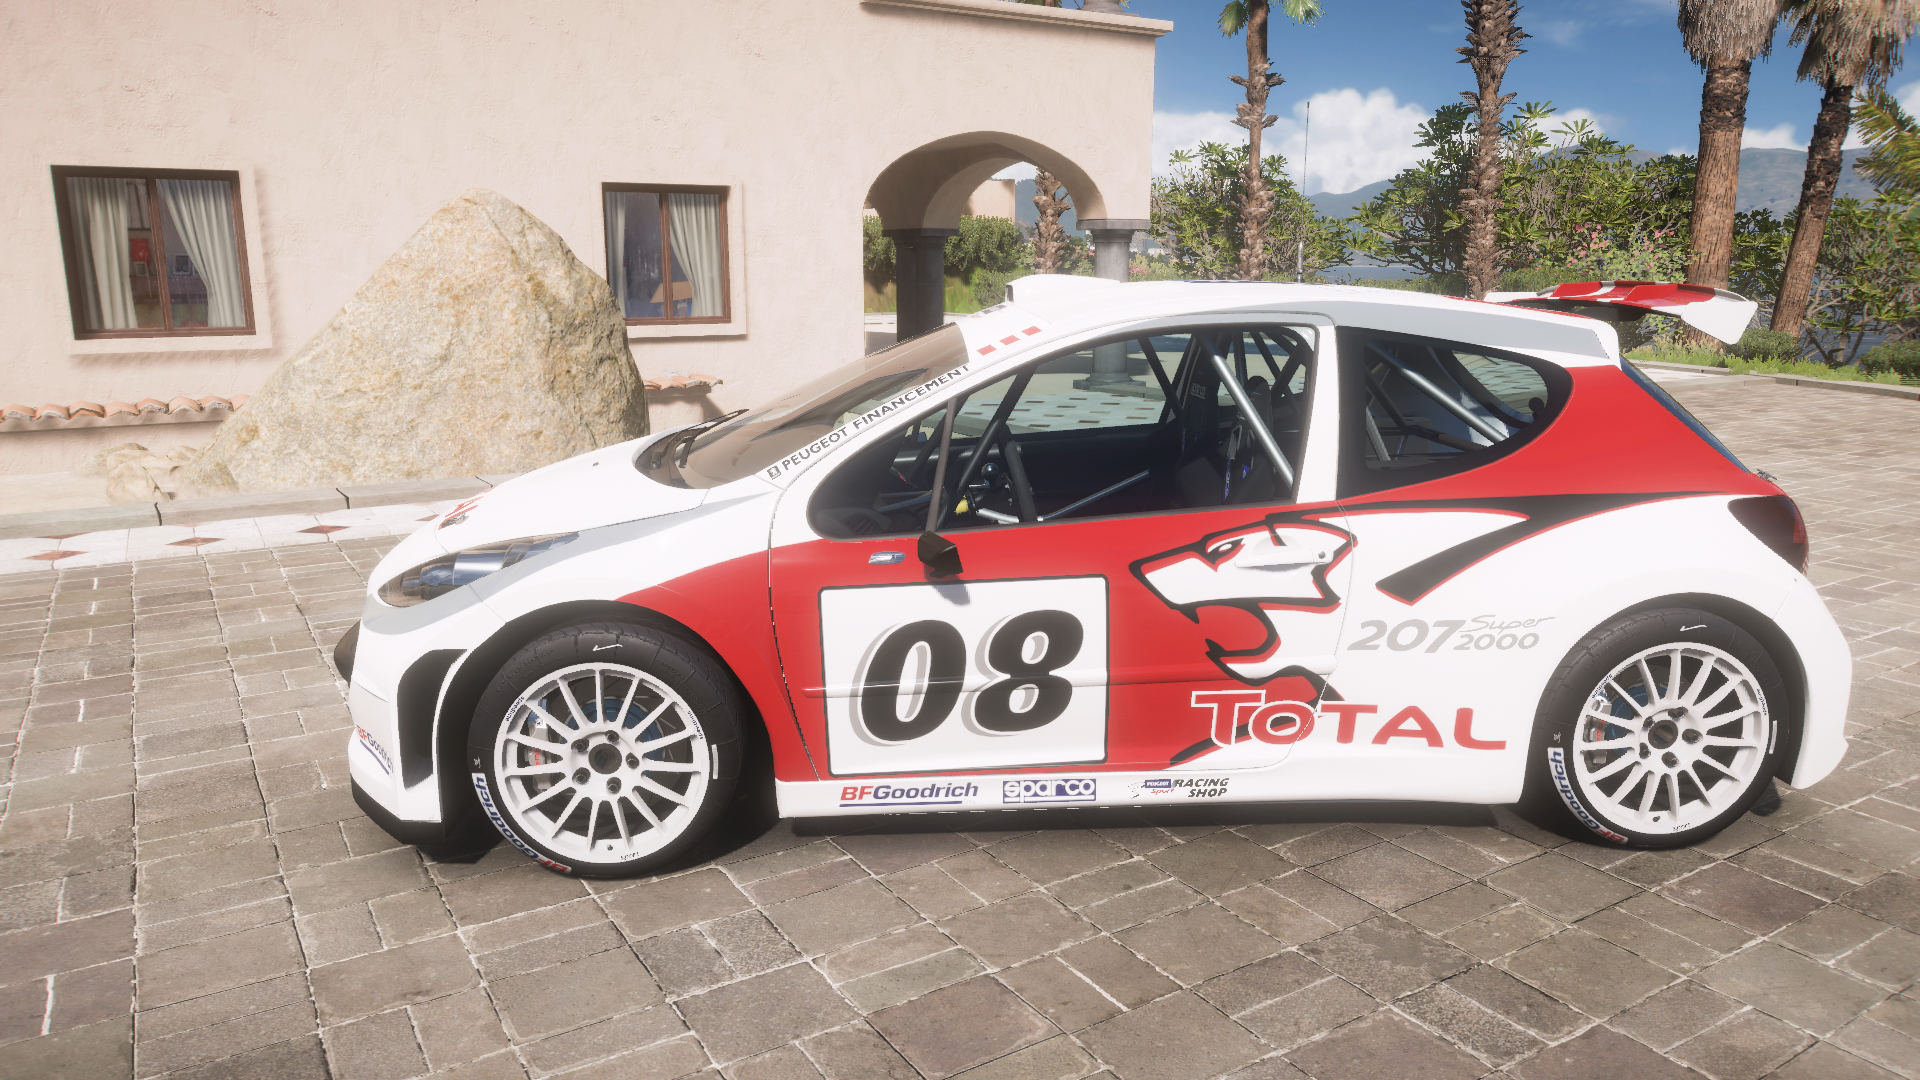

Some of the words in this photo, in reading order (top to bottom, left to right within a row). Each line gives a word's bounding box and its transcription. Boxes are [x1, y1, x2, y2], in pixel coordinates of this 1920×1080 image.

[782, 427, 848, 471] PEUGEOT
[852, 364, 969, 429] FINANCEMENT
[1460, 614, 1556, 632] Super
[1347, 618, 1466, 653] 207
[1452, 633, 1541, 651] 2000
[850, 609, 1083, 746] 08
[839, 782, 978, 801] BFGoodrich
[1004, 779, 1096, 799] sparco
[1172, 778, 1229, 788] RACING
[1188, 788, 1228, 797] SHOP
[1551, 751, 1625, 844] BFGoodrich
[475, 776, 569, 873] BFGoodrich
